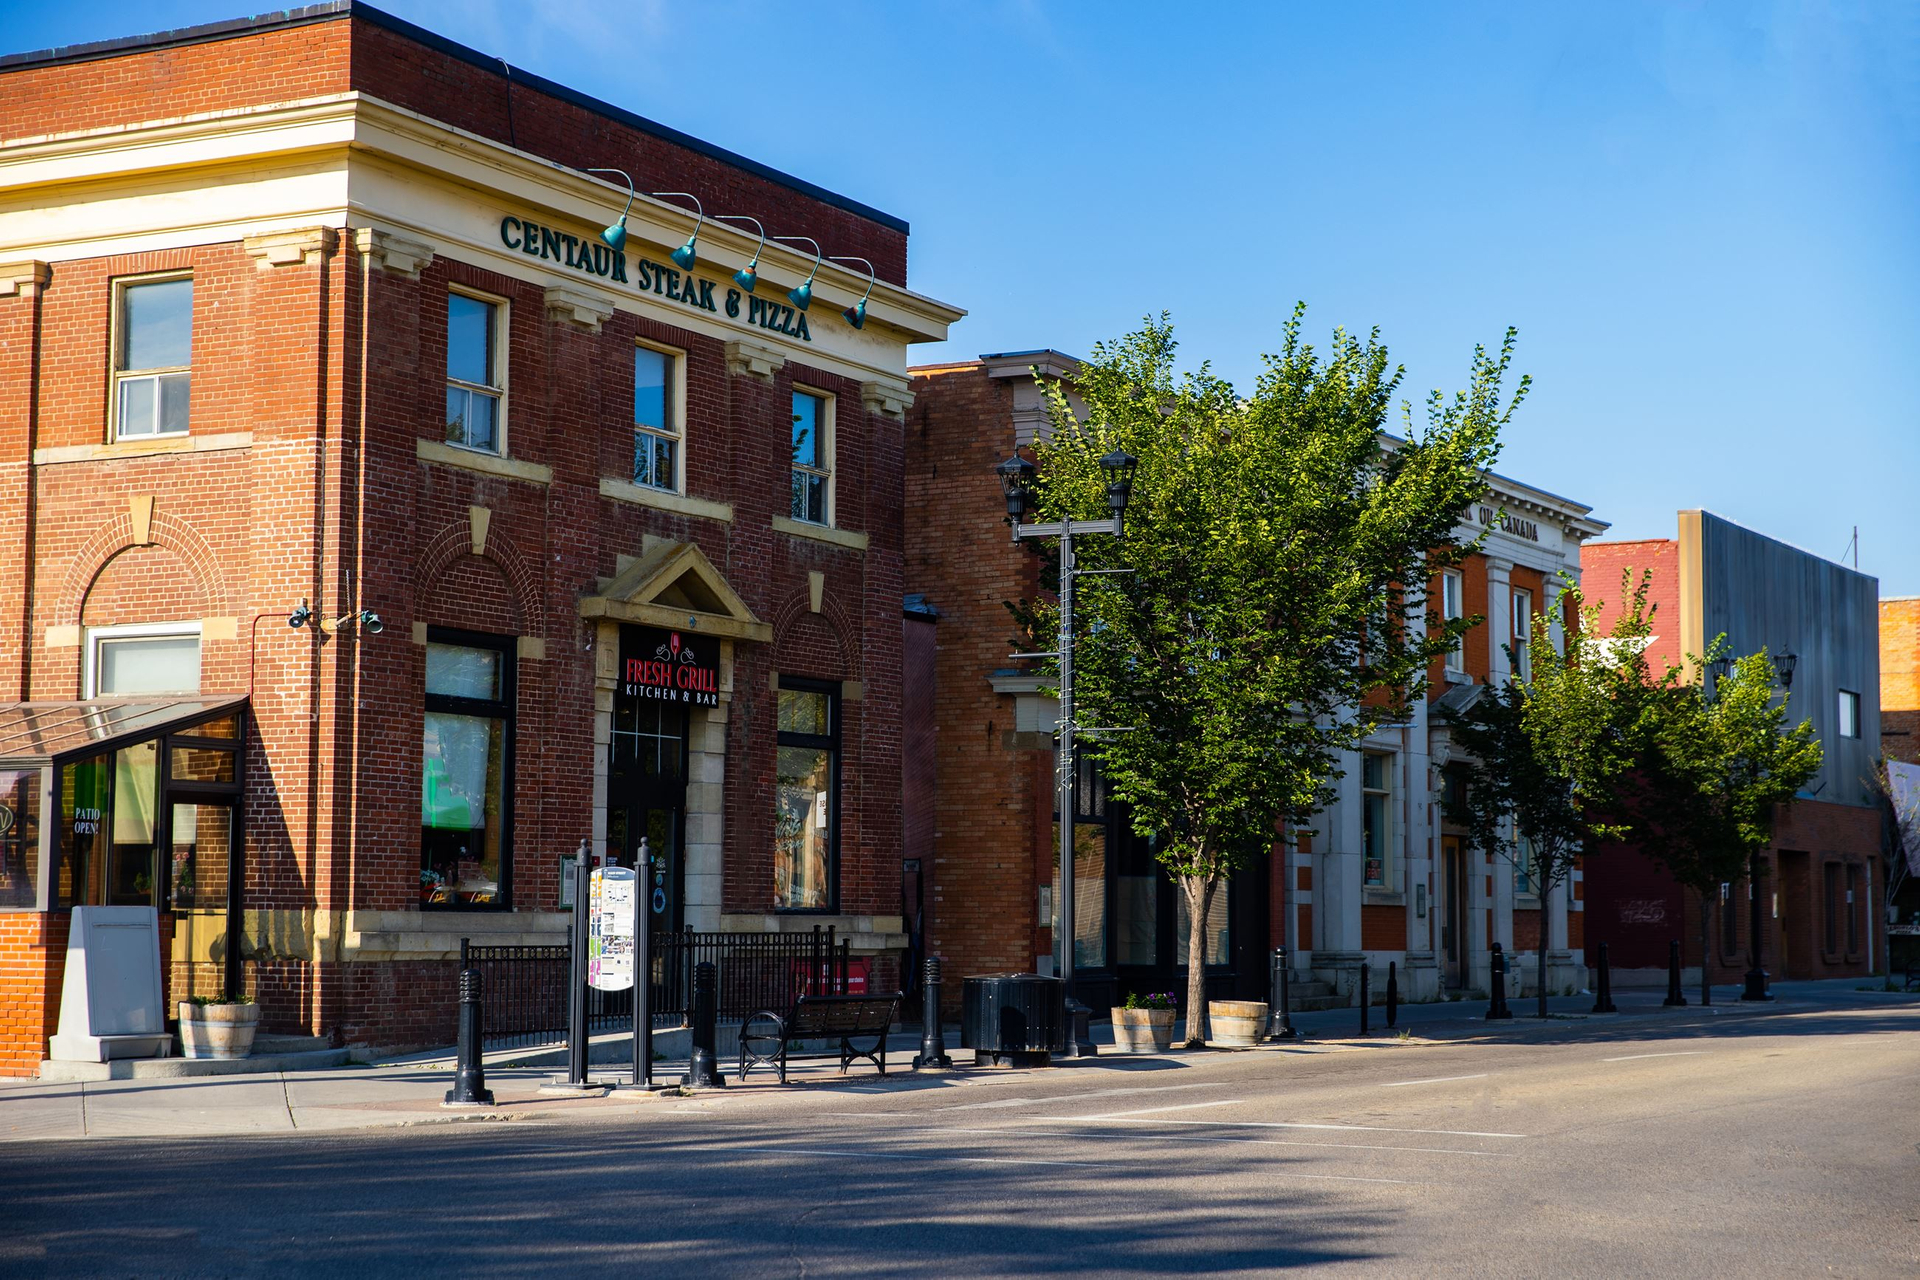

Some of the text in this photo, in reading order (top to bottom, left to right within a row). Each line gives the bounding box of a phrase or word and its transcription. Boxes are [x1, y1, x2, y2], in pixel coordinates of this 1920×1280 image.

[501, 216, 812, 341] CENTAUR STEAK & PIZZA
[1500, 514, 1539, 541] CANADA
[626, 658, 717, 693] FRESH GRILL
[626, 684, 717, 705] KITCHEN & BAR
[75, 807, 100, 820] PATIO
[74, 821, 99, 835] OPEN!
